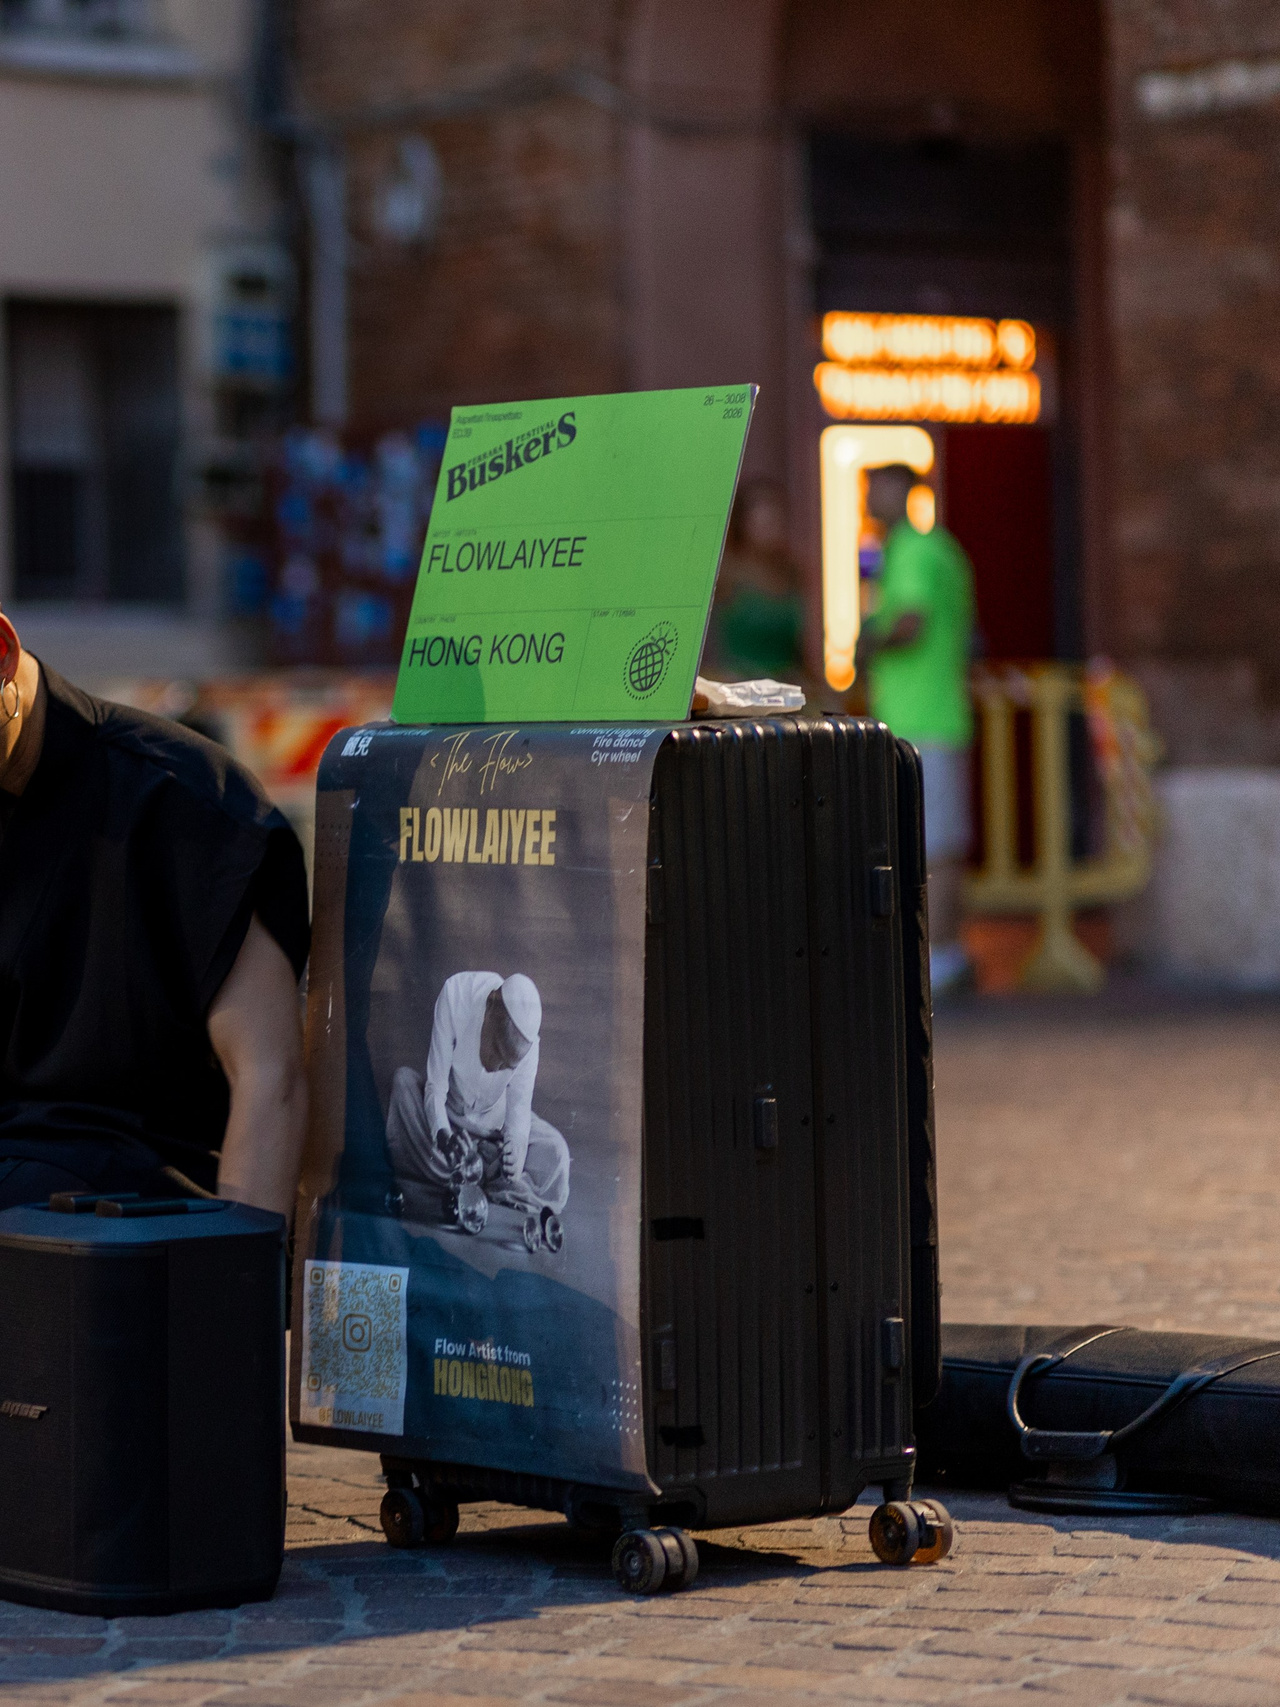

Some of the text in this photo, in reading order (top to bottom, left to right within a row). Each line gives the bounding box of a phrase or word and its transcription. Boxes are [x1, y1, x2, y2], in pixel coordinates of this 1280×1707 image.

[722, 407, 742, 419] 2026
[515, 419, 555, 444] FESTIVAL
[446, 411, 577, 503] BuskerS
[427, 536, 587, 574] FLOWLAIYEE
[409, 632, 565, 667] HONG KONG
[593, 734, 646, 748] Fire dance
[591, 749, 641, 766] Cyr wheel
[399, 807, 557, 866] FLOWLAIYEE
[434, 1338, 531, 1366] Flow Artist from
[434, 1358, 534, 1408] HONGKONG
